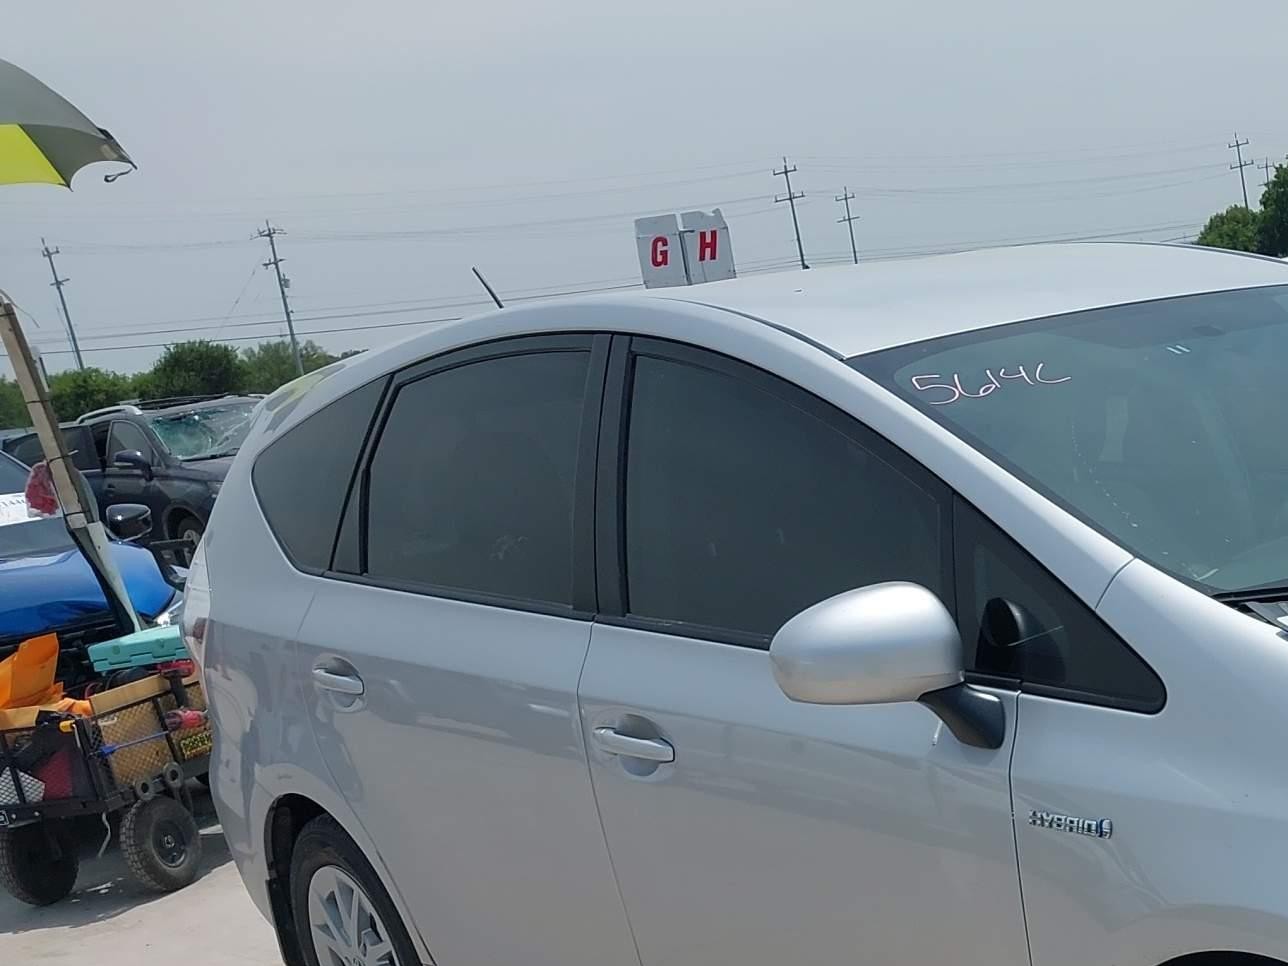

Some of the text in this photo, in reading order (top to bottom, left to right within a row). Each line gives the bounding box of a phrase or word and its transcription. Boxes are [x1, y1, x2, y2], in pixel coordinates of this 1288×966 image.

[651, 229, 718, 267] G H
[1028, 809, 1098, 837] HYBRID
